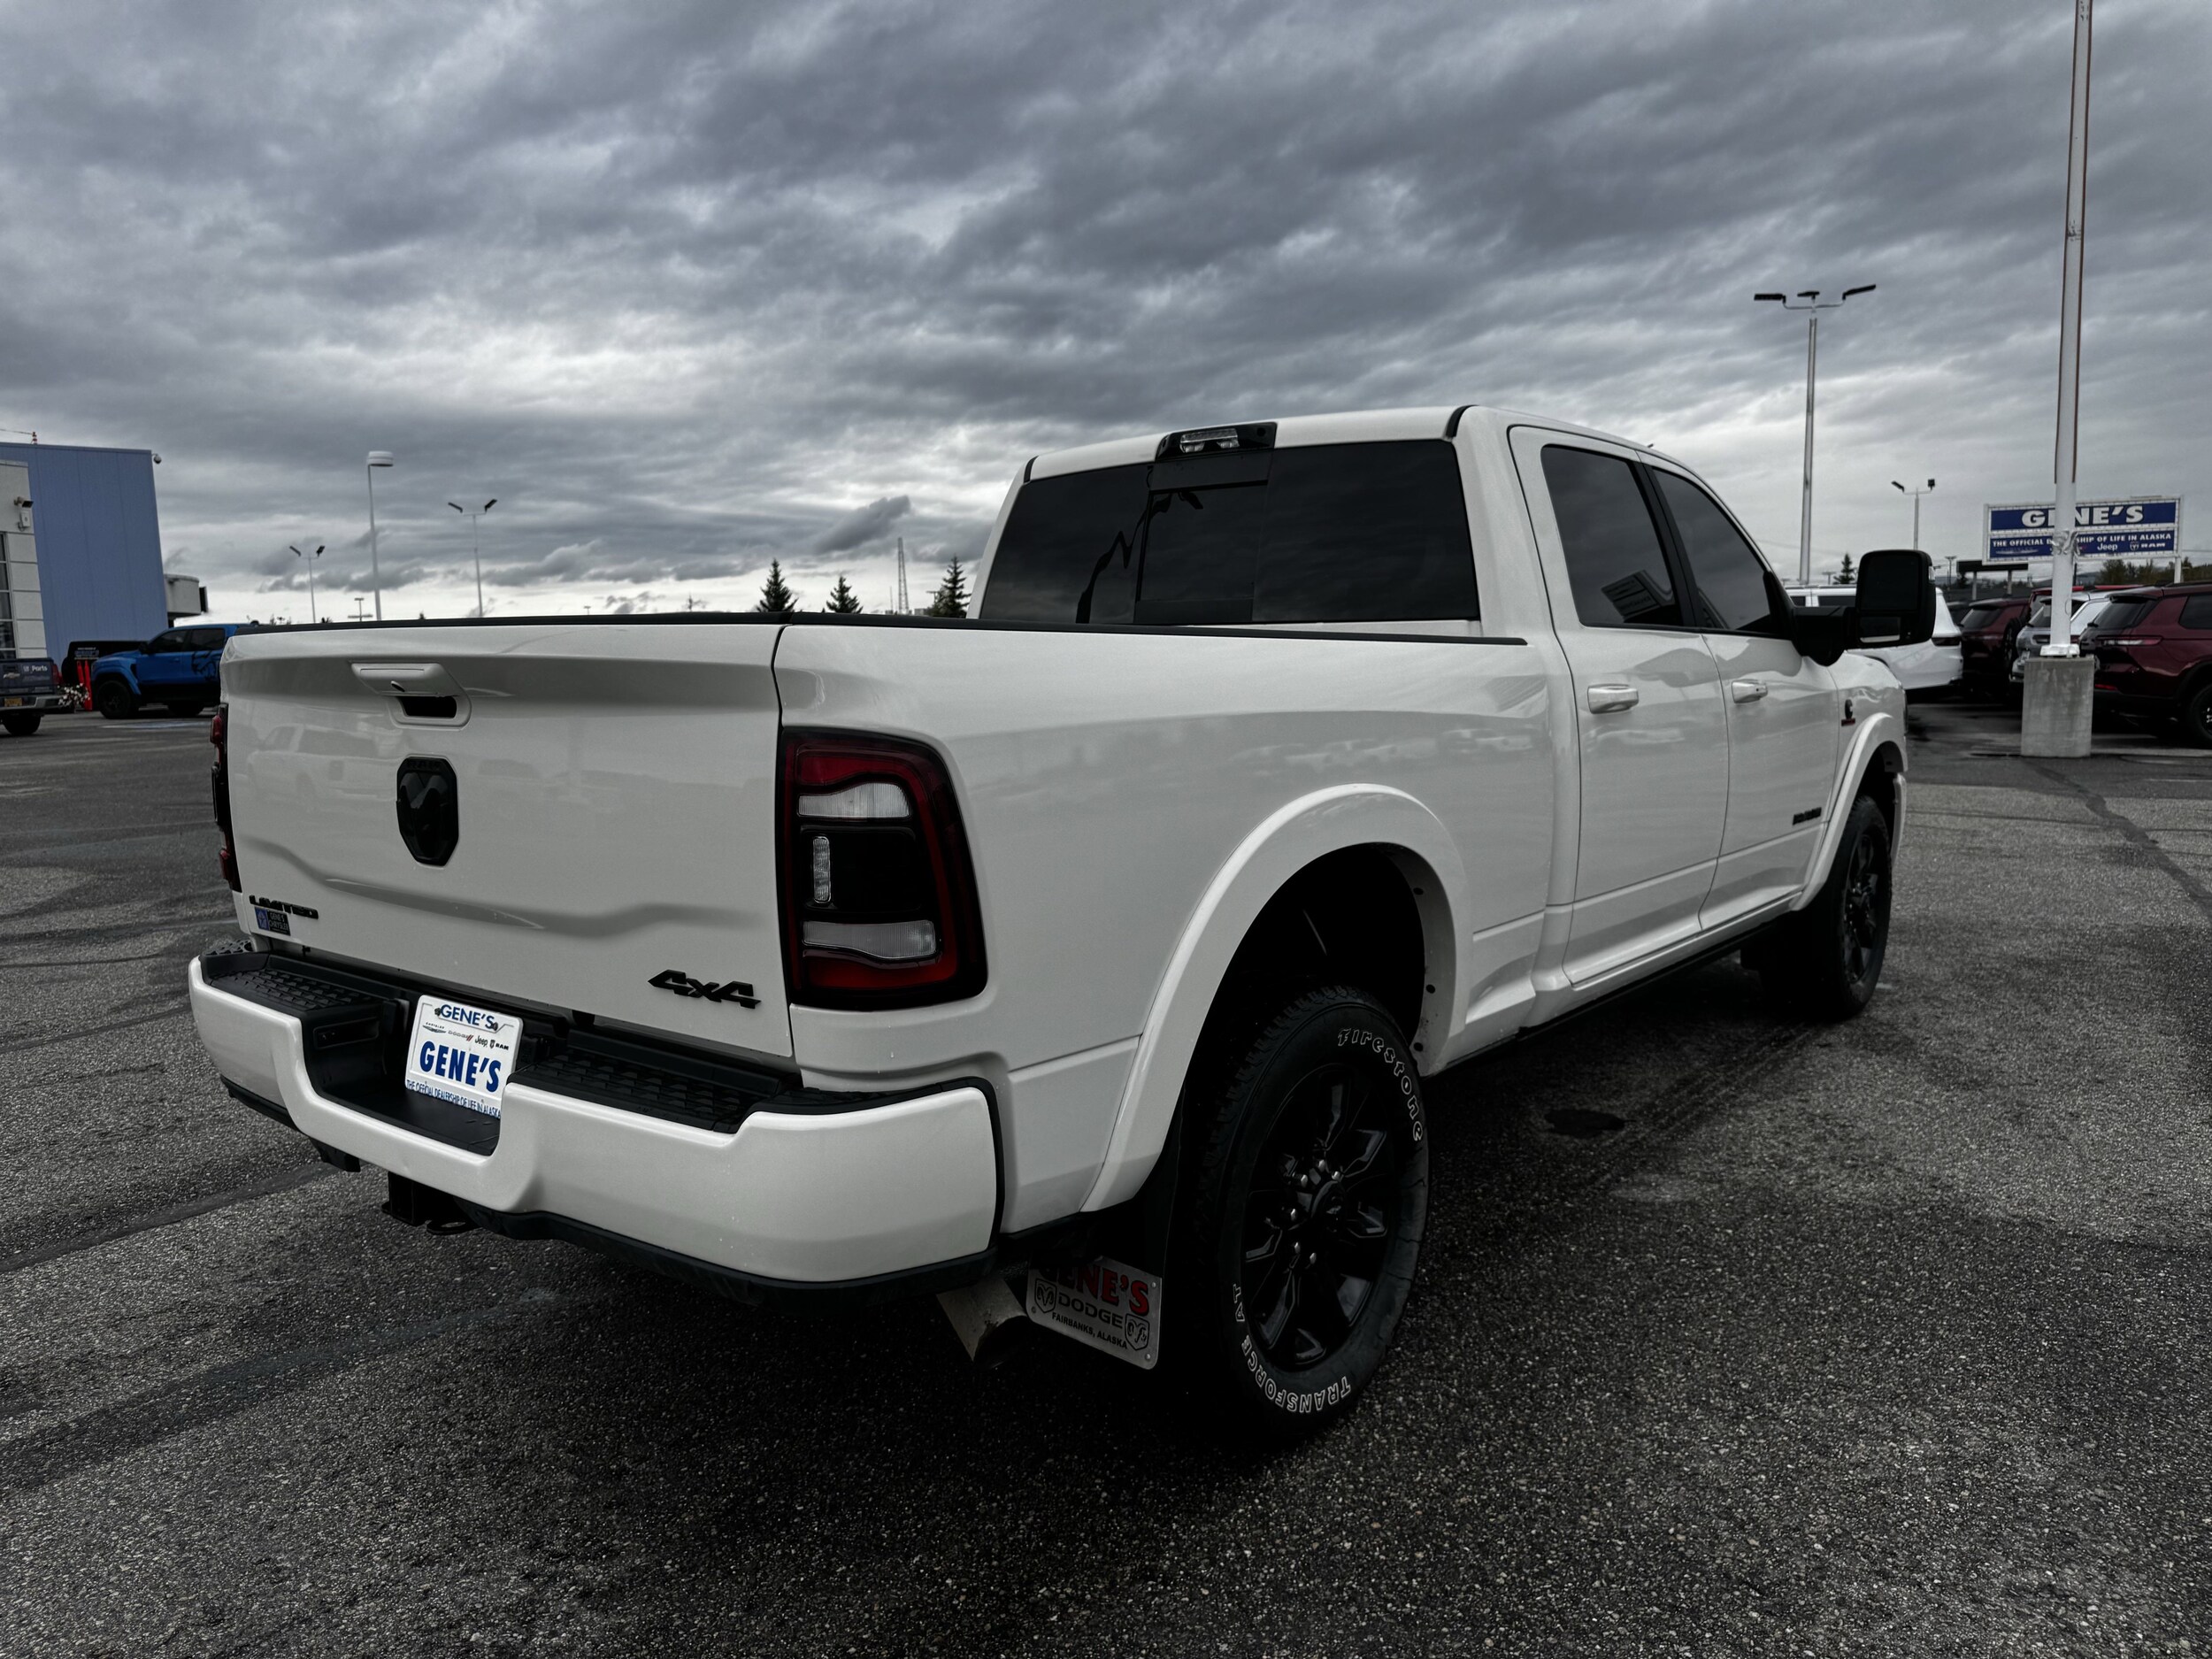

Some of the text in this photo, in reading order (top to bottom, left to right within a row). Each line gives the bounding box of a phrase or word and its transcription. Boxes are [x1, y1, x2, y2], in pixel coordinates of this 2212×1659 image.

[2009, 538, 2044, 547] OFFICIAL
[2097, 542, 2118, 551] Jeep
[441, 1004, 495, 1030] GENE'S
[475, 1035, 488, 1048] Jeep
[419, 1041, 502, 1093] GENE'S
[1338, 1027, 1424, 1141] Firestone
[407, 1079, 416, 1090] THE
[416, 1082, 434, 1096] OFFICIAL
[434, 1087, 460, 1105] DEALERSHIP
[460, 1096, 468, 1107] OF
[477, 1102, 483, 1112] IN
[1044, 1263, 1150, 1317] ENE'S
[1058, 1292, 1123, 1329] DODGE
[1052, 1312, 1128, 1349] FAIRBANKS, ALASKA
[1233, 1283, 1352, 1414] TRANSFORCE AT
